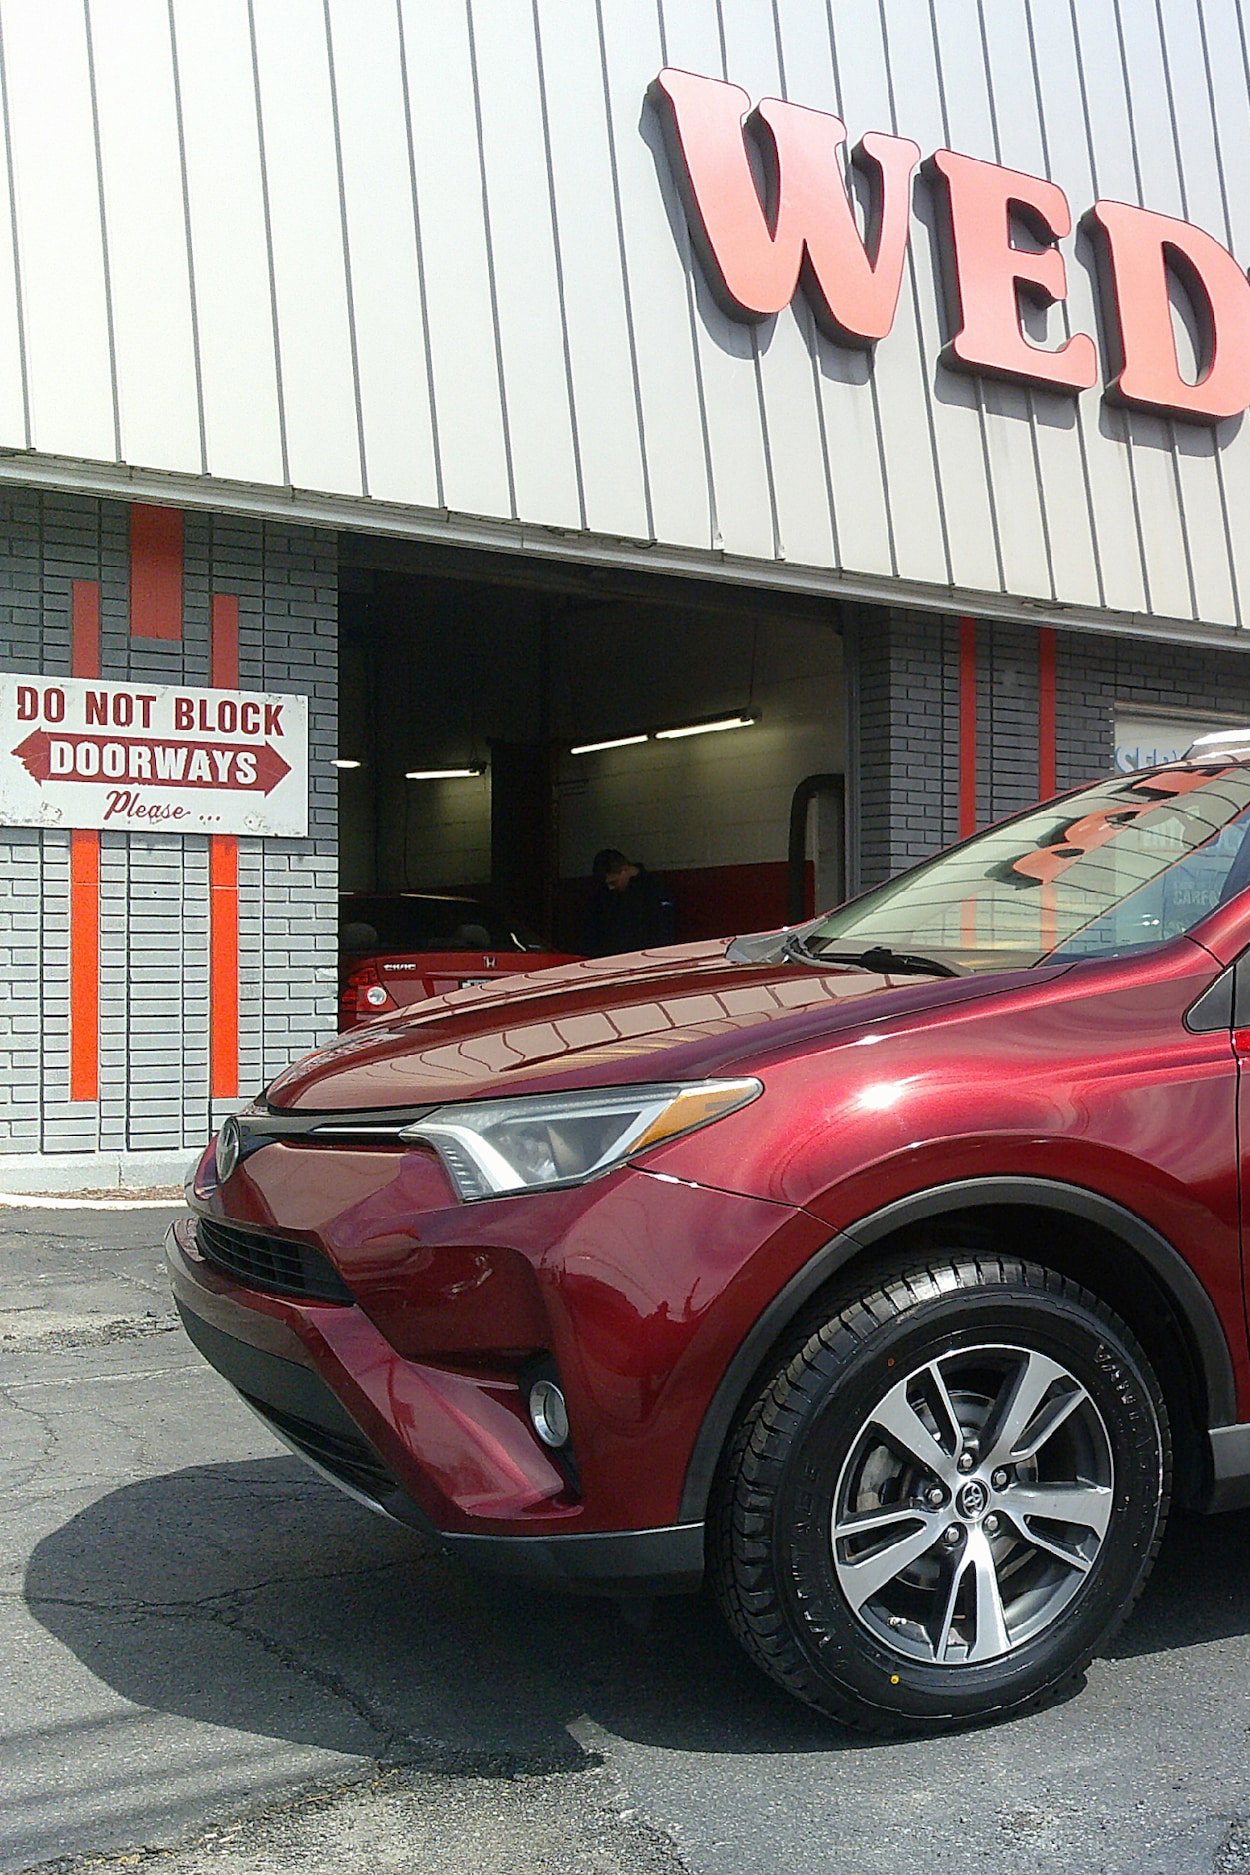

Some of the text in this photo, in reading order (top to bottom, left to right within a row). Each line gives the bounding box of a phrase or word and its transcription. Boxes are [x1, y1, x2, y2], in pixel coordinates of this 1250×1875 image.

[17, 686, 285, 737] DO NOT BLOCK
[49, 740, 258, 784] DOORWAYS
